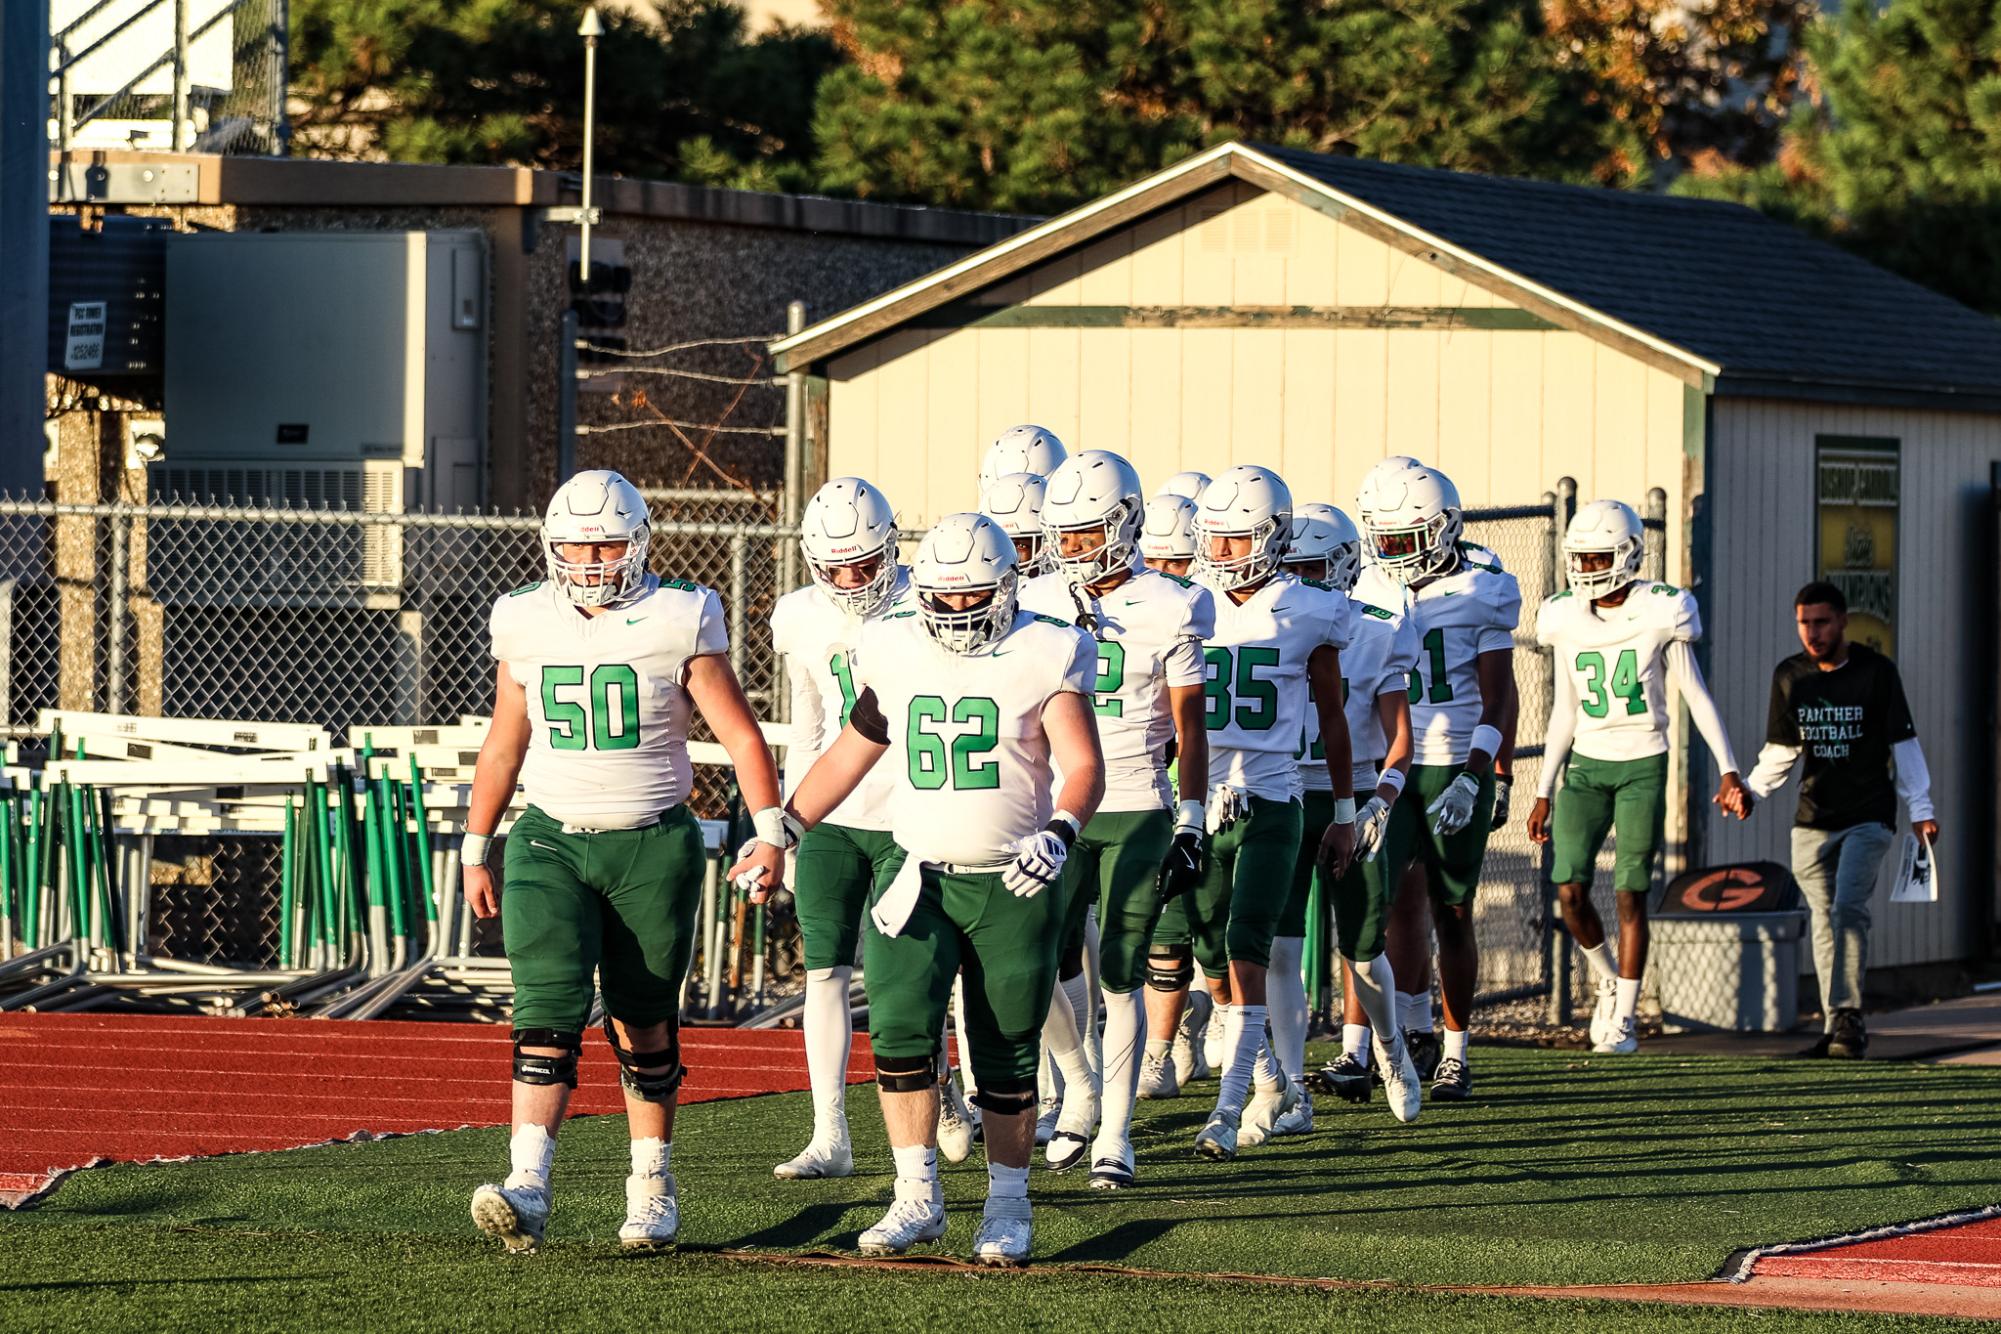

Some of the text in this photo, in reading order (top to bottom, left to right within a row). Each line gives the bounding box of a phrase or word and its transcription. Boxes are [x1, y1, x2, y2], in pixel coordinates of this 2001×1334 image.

[831, 545, 857, 554] Riddell
[1824, 569, 1892, 624] AMPIONS
[1576, 649, 1647, 718] 34
[541, 664, 641, 751] 50
[1797, 706, 1863, 722] PANTHER
[906, 695, 1000, 790] 62
[1798, 725, 1864, 740] FOOTBALL
[1813, 744, 1850, 758] COACH
[1681, 868, 1765, 910] G
